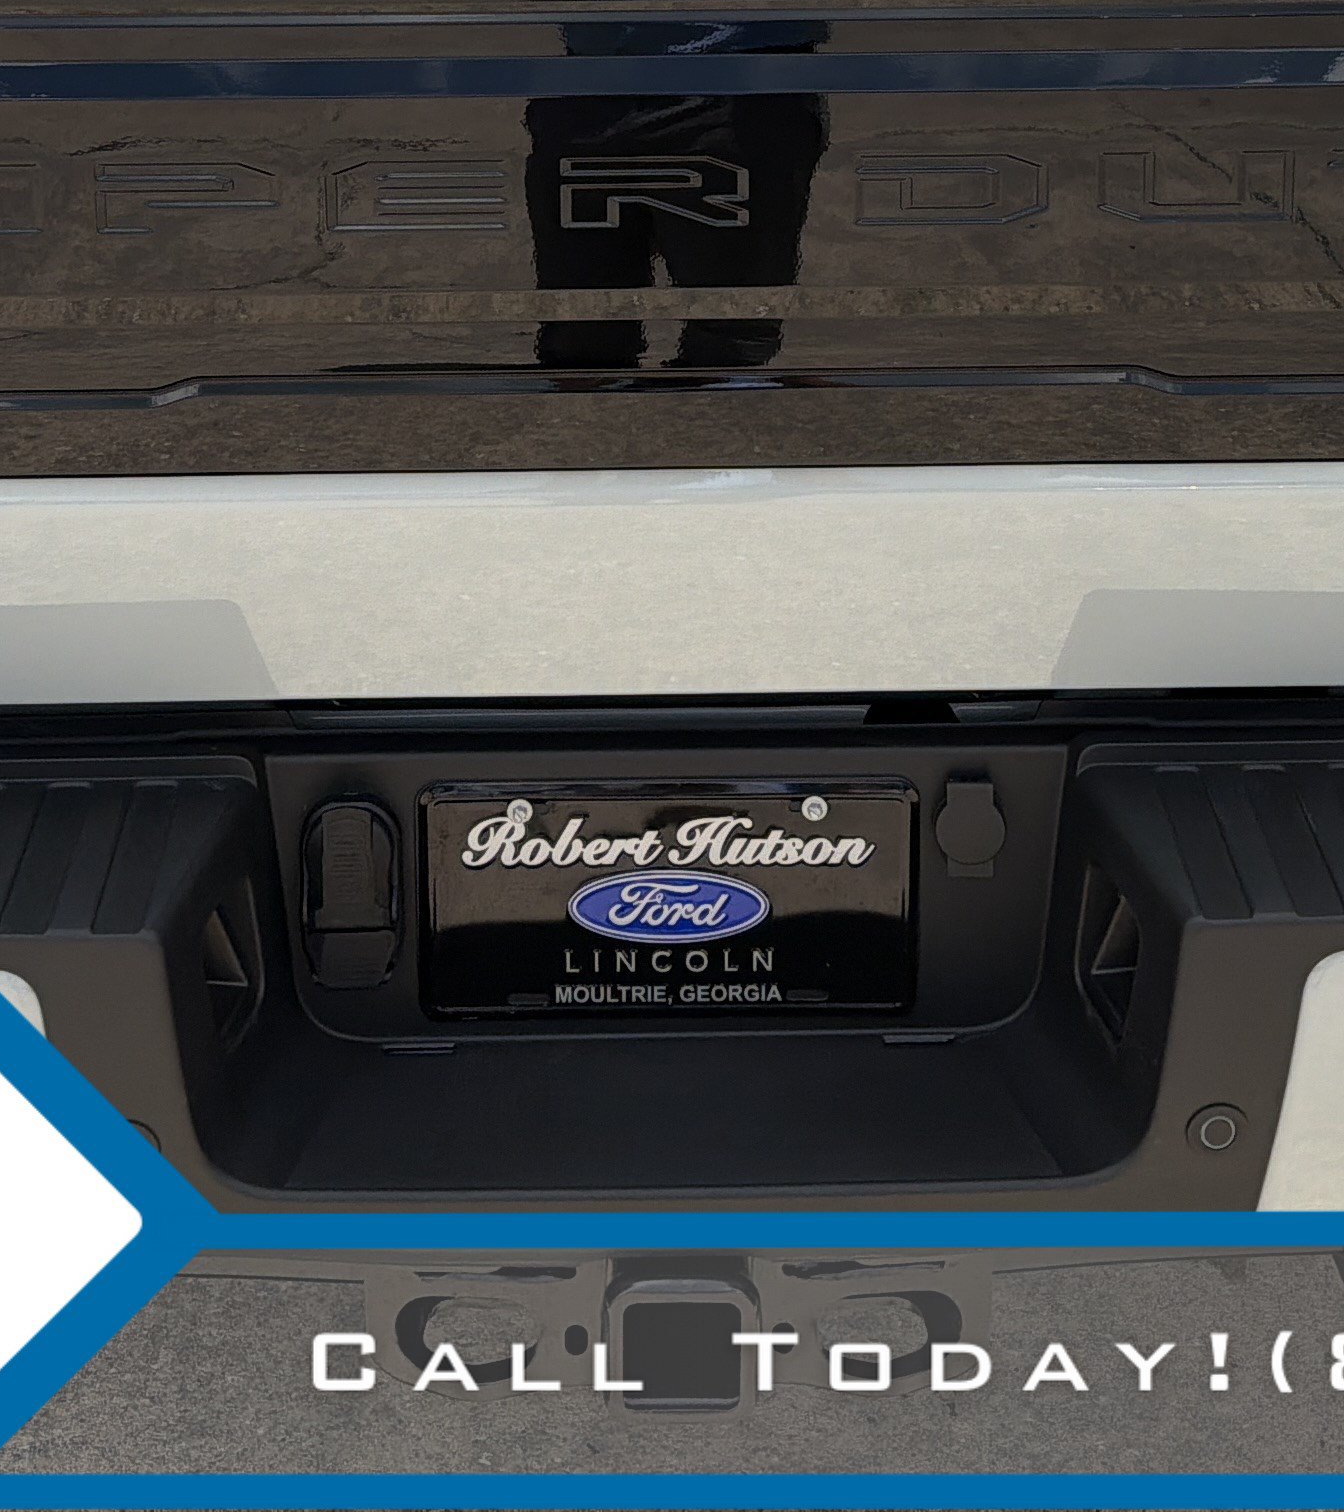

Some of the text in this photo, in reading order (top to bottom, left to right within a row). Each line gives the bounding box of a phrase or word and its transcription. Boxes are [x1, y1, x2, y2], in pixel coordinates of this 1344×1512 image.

[461, 815, 875, 868] Robert Hutson
[607, 882, 729, 928] Ford
[564, 947, 774, 973] LINCOLN
[554, 983, 782, 1006] MOULTRIE, GEORGIA
